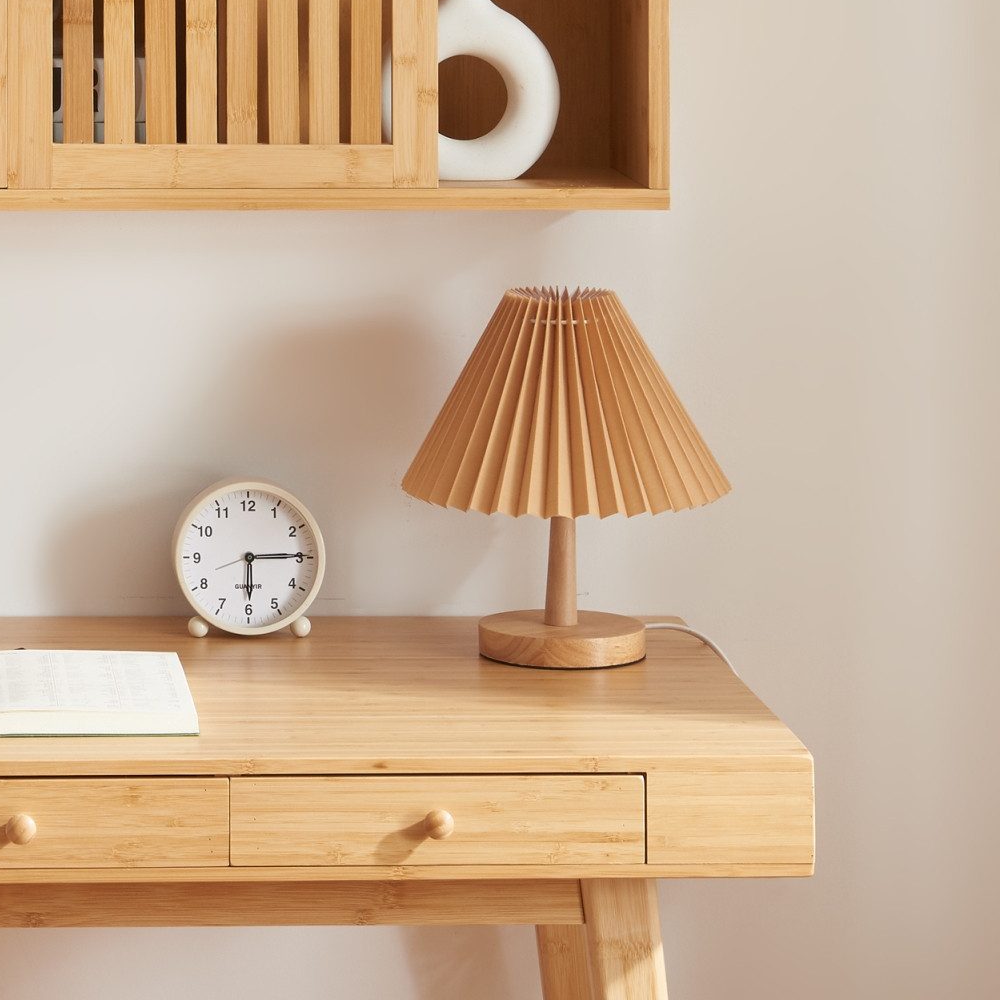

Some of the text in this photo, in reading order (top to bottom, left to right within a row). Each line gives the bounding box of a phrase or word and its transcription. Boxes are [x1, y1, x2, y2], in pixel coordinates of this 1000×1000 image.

[239, 500, 256, 512] 12
[215, 507, 229, 519] 11
[270, 507, 278, 519] 1
[197, 526, 213, 538] 10
[288, 526, 297, 538] 2
[193, 552, 202, 564] 9
[295, 552, 304, 564] 3
[200, 578, 208, 590] 8
[288, 578, 297, 589] 4
[218, 598, 226, 610] 7
[270, 598, 279, 609] 5
[244, 604, 253, 616] 6
